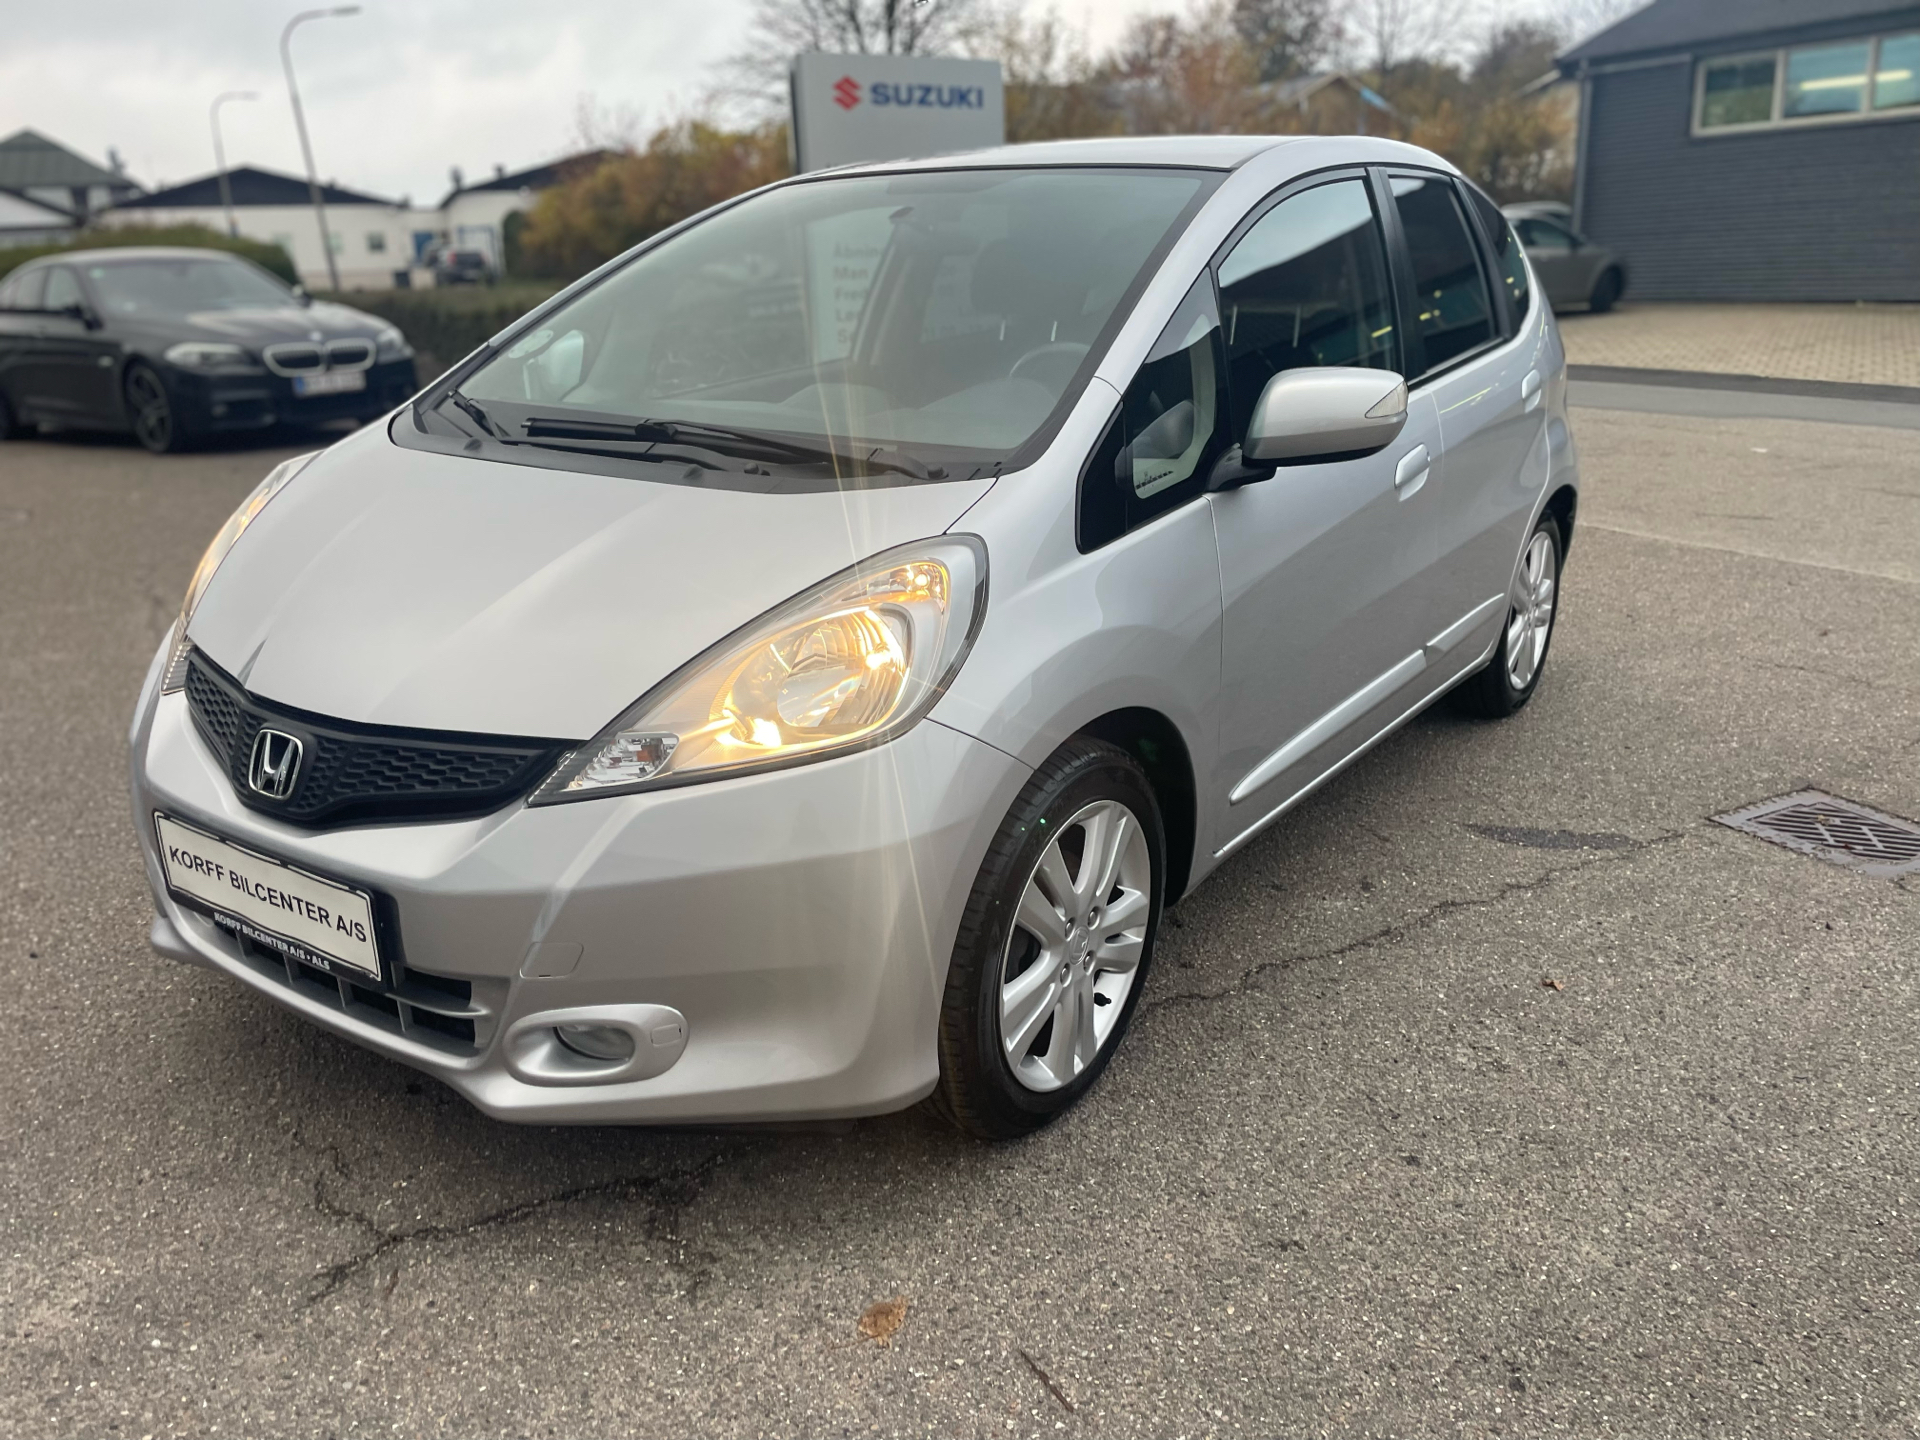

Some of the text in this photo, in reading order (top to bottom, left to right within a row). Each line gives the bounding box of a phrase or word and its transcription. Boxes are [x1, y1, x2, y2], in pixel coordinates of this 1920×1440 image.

[870, 83, 984, 109] SUZUKI
[169, 845, 367, 943] KORFF BILCENTER A/S
[214, 912, 330, 970] KORFF BILCENTER A/S ALS
